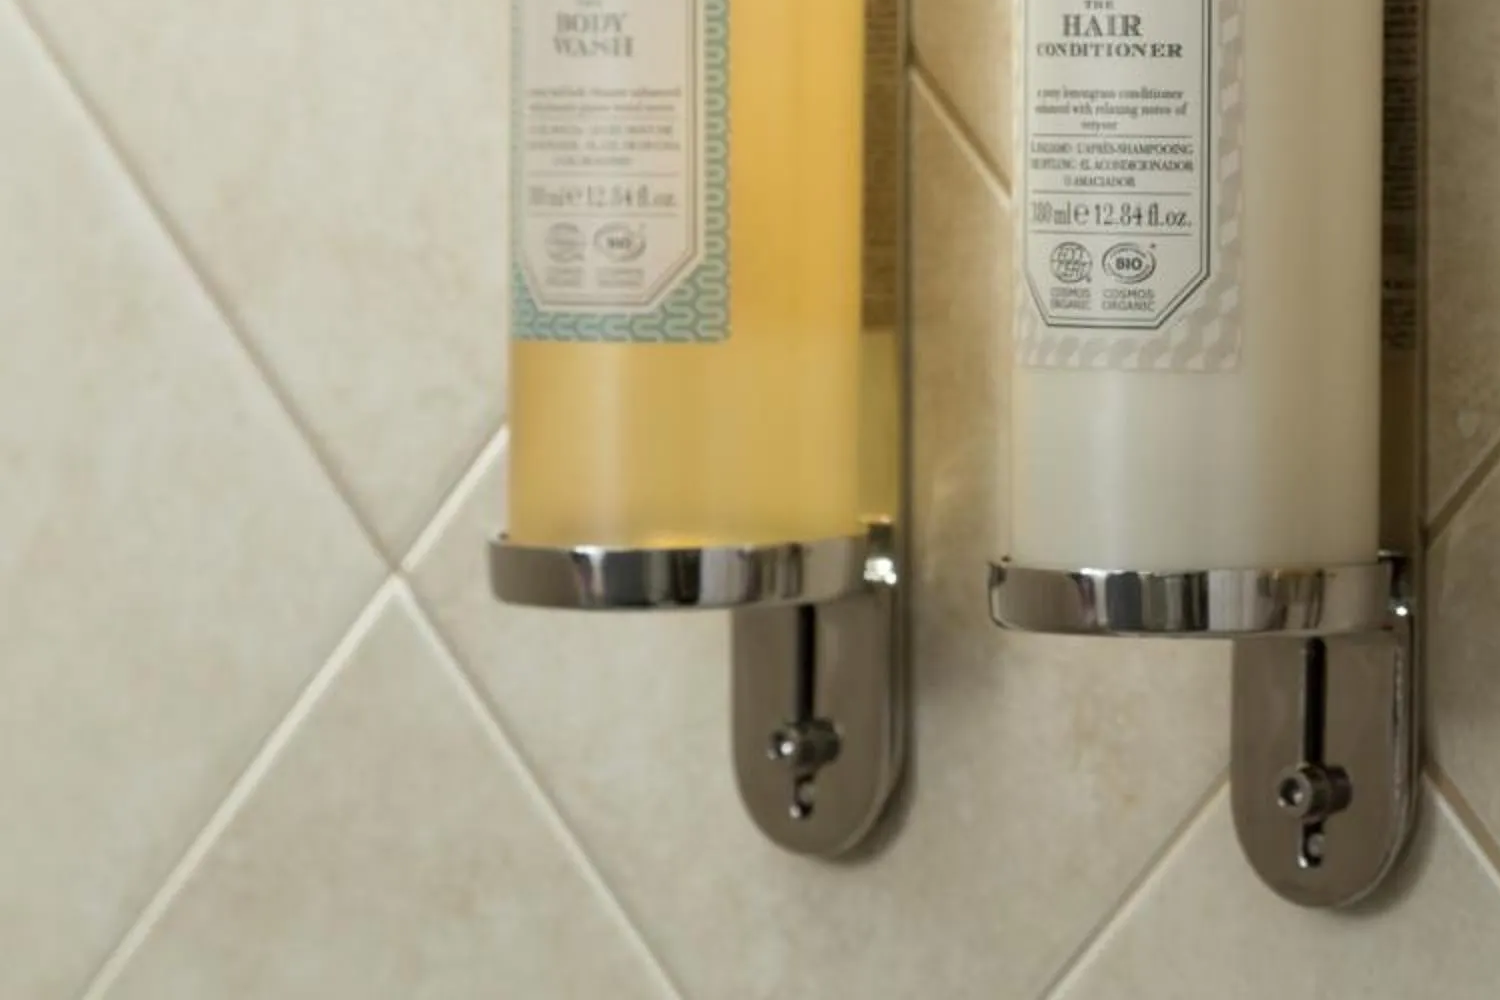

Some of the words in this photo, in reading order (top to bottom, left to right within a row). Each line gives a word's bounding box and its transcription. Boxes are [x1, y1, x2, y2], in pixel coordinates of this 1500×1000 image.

[1062, 13, 1142, 37] HAIR
[553, 36, 634, 57] WASH
[1036, 43, 1183, 59] CONDITIONER
[1095, 201, 1142, 226] 12.84
[1115, 256, 1142, 271] BIO
